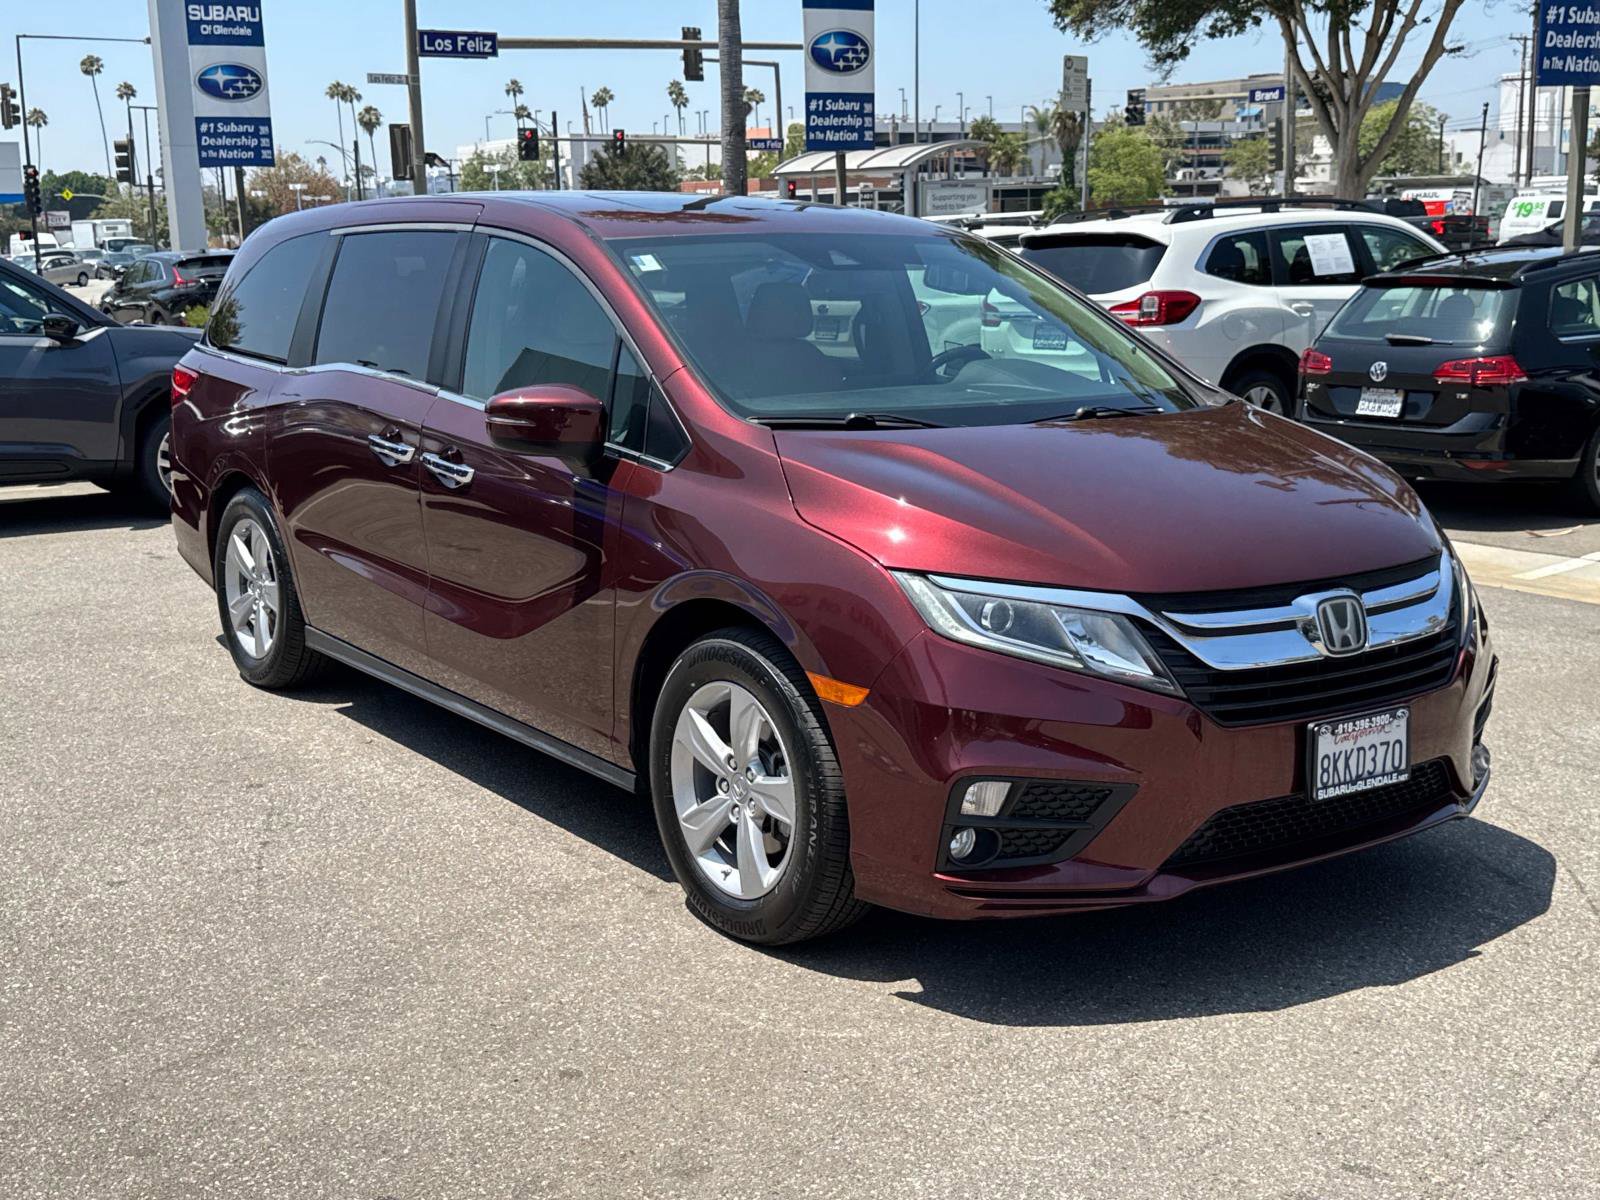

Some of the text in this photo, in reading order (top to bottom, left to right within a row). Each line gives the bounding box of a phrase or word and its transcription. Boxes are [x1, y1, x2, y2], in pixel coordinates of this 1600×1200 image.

[187, 4, 260, 22] SUBARU
[1546, 5, 1565, 24] #1
[200, 24, 252, 36] Of Glendale
[423, 34, 493, 53] Los Feliz
[1551, 56, 1563, 70] The
[1254, 89, 1280, 101] Brand
[809, 99, 823, 111] #1
[825, 99, 860, 111] Subaru
[809, 115, 863, 128] Dealership
[200, 122, 215, 134] #1
[216, 122, 254, 133] Subaru
[201, 135, 258, 148] Dealership
[825, 130, 858, 141] Nation
[752, 141, 782, 149] Los Feliz
[219, 149, 254, 159] Nation
[1320, 738, 1403, 787] 8KKD370
